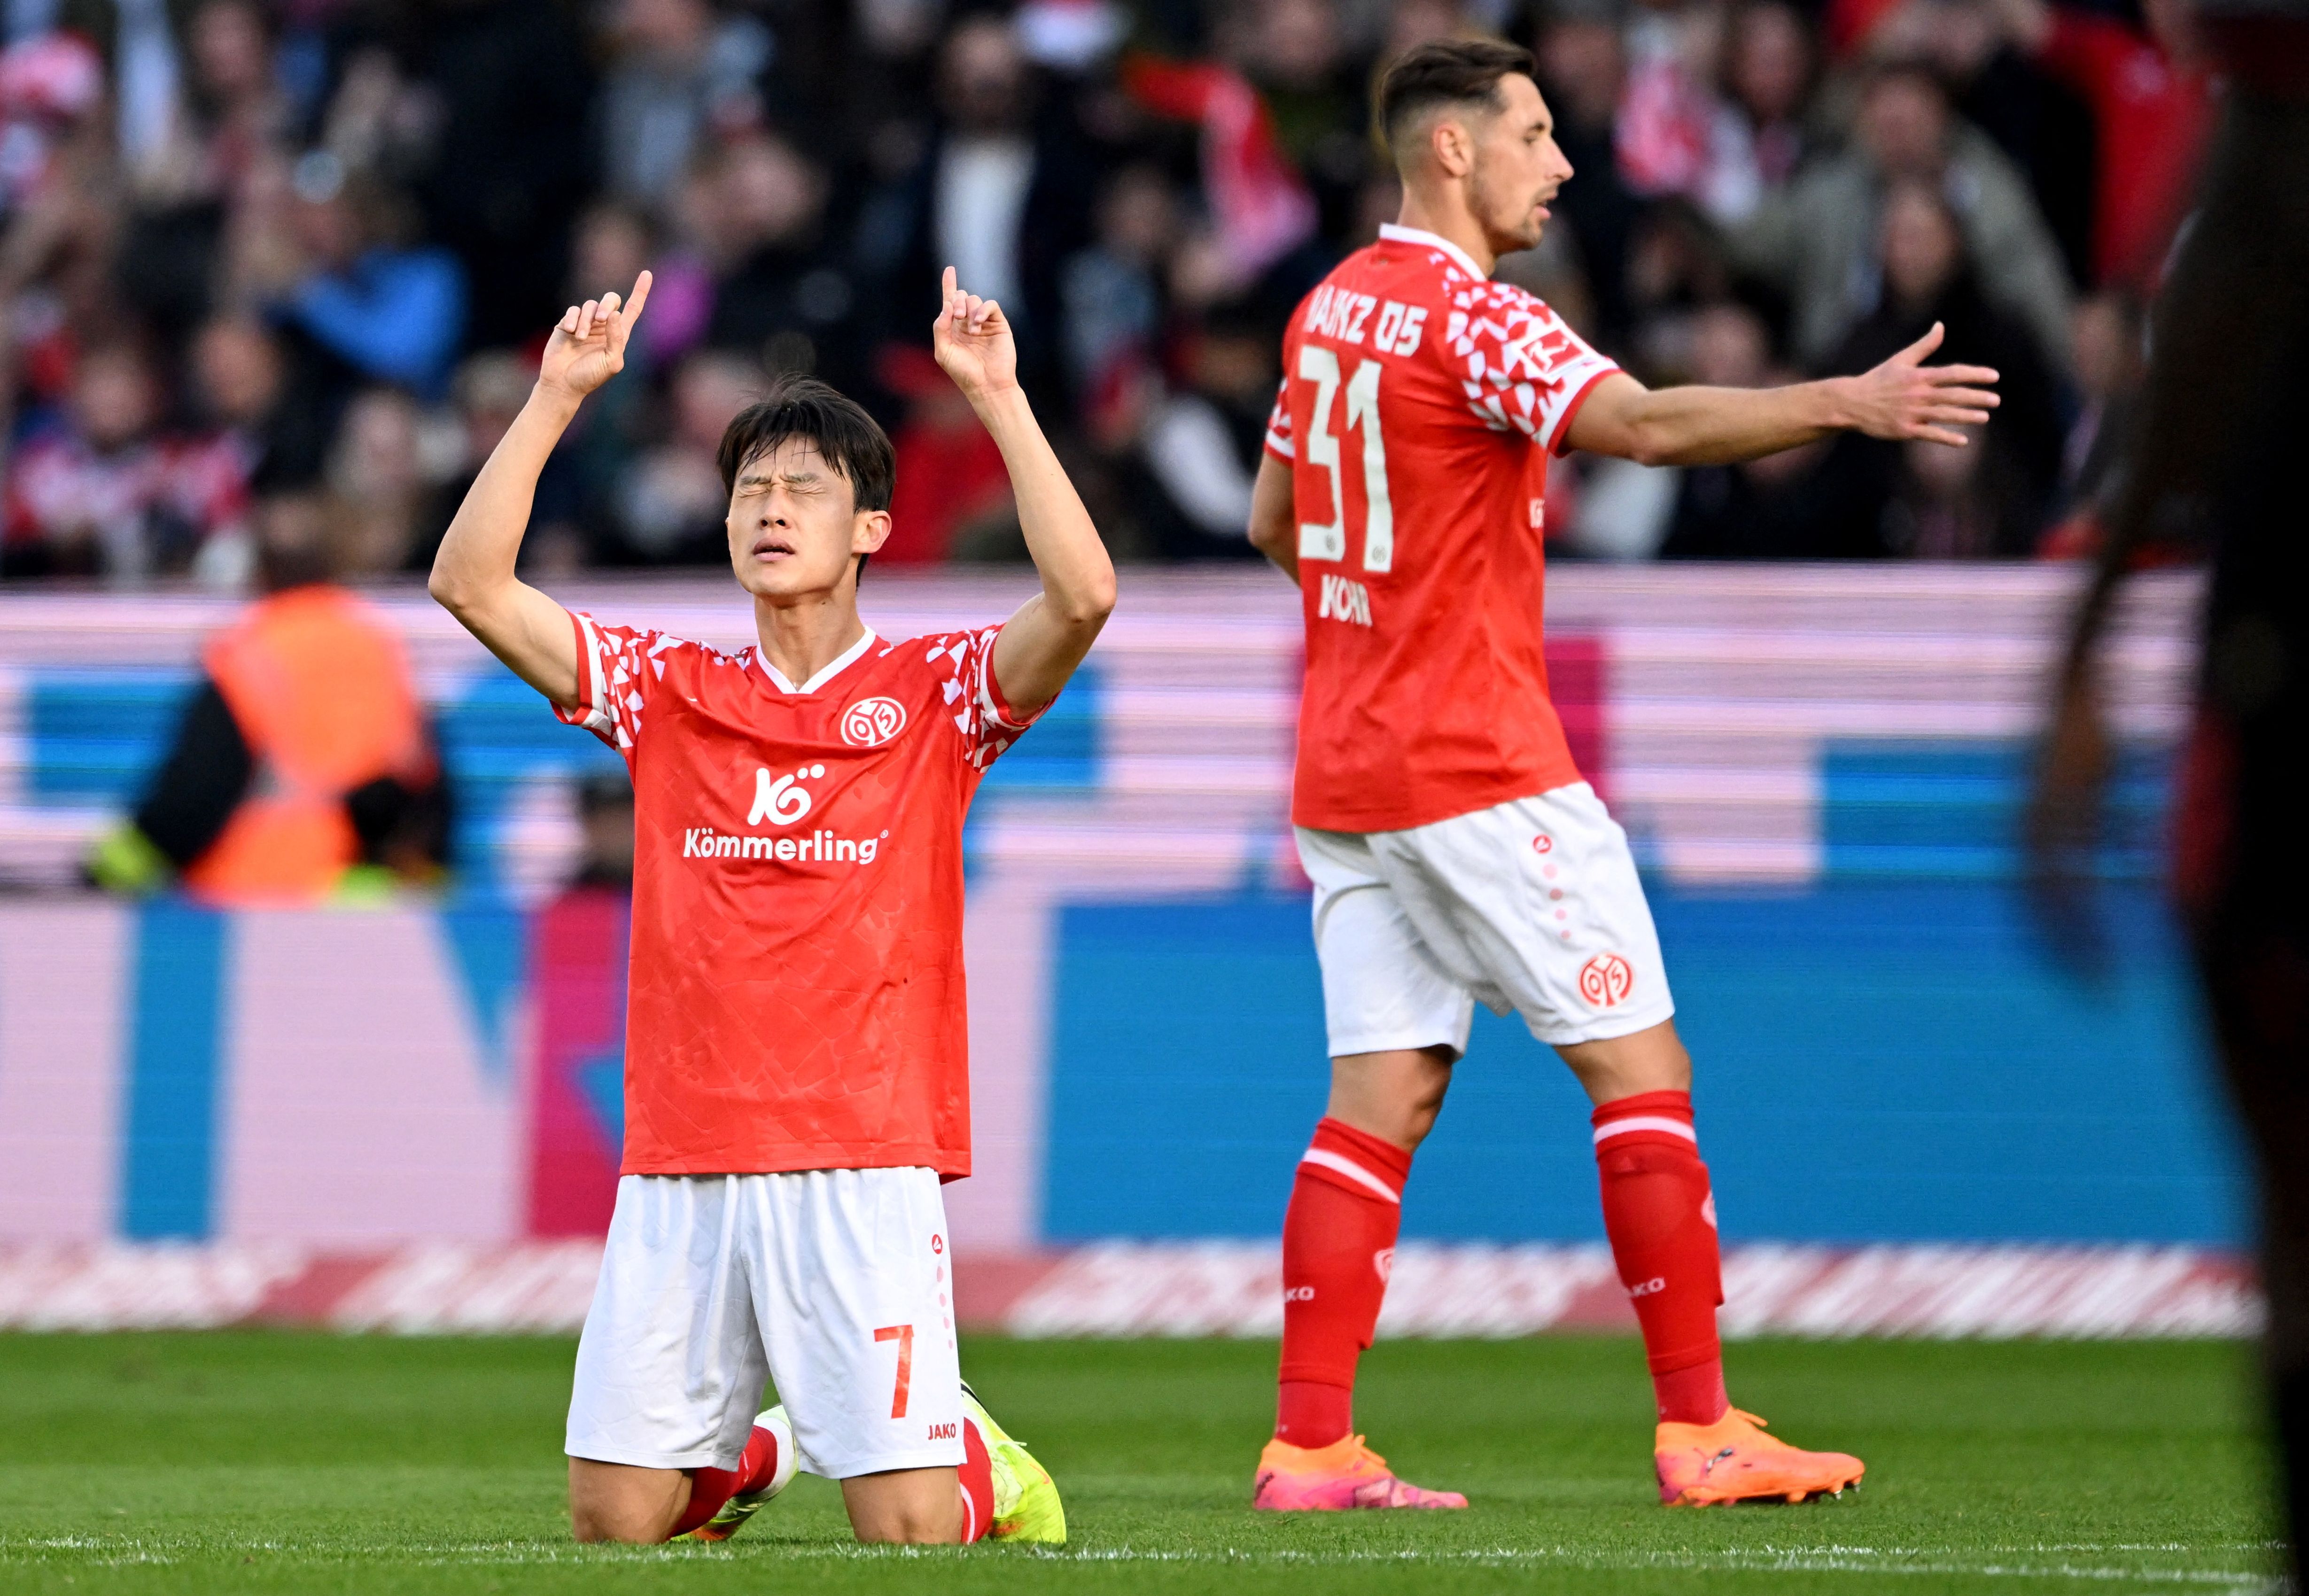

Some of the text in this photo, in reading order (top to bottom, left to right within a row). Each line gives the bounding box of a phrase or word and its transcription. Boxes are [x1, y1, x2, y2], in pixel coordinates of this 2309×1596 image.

[1374, 299, 1428, 357] 05
[1299, 344, 1393, 572] 31
[1285, 1286, 1314, 1302] KO
[1630, 1277, 1666, 1297] KO
[874, 1324, 914, 1419] 7
[928, 1423, 956, 1440] JAKO
